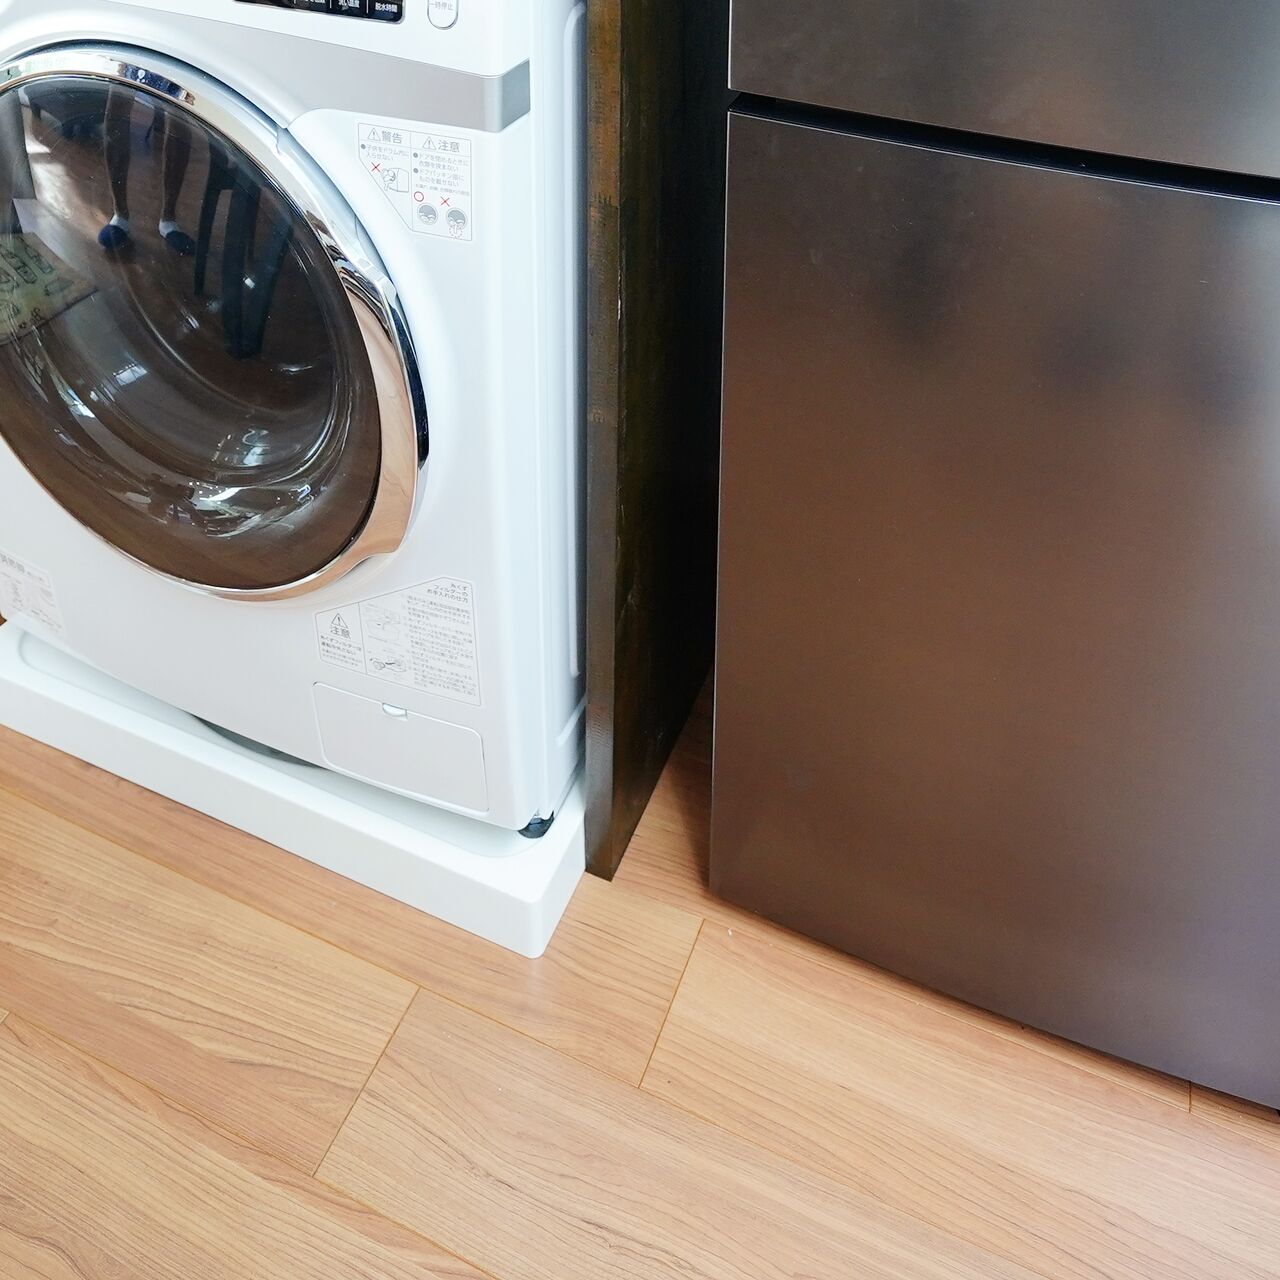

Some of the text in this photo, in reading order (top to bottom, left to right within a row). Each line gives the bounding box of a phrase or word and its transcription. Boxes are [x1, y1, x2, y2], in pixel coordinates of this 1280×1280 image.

[374, 2, 398, 13] 脱水時間
[381, 130, 402, 144] 警告
[438, 139, 460, 153] 注意
